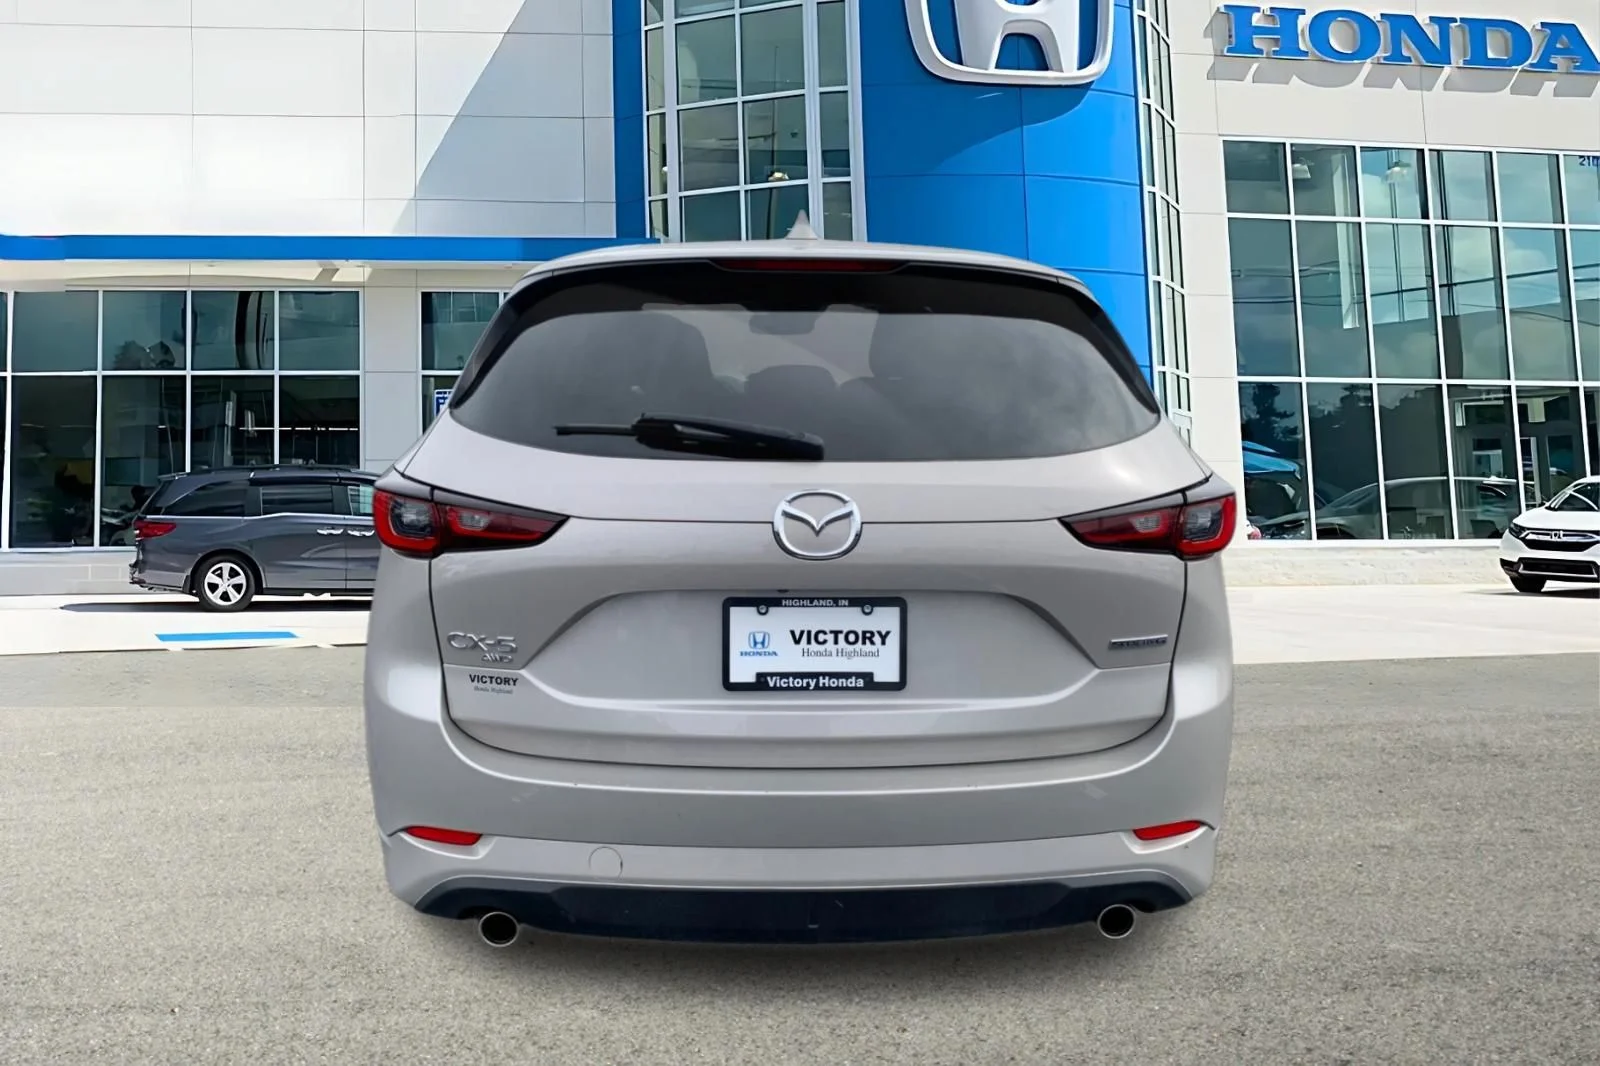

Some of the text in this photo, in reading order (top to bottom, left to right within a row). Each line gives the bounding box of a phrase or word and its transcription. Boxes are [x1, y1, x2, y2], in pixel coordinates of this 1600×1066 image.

[1222, 5, 1600, 73] HONDA
[447, 632, 517, 653] CX-5
[790, 630, 891, 646] VICTORY
[801, 648, 880, 659] Honda Highland
[469, 674, 519, 686] VICTORY
[767, 676, 864, 690] Victory Honda
